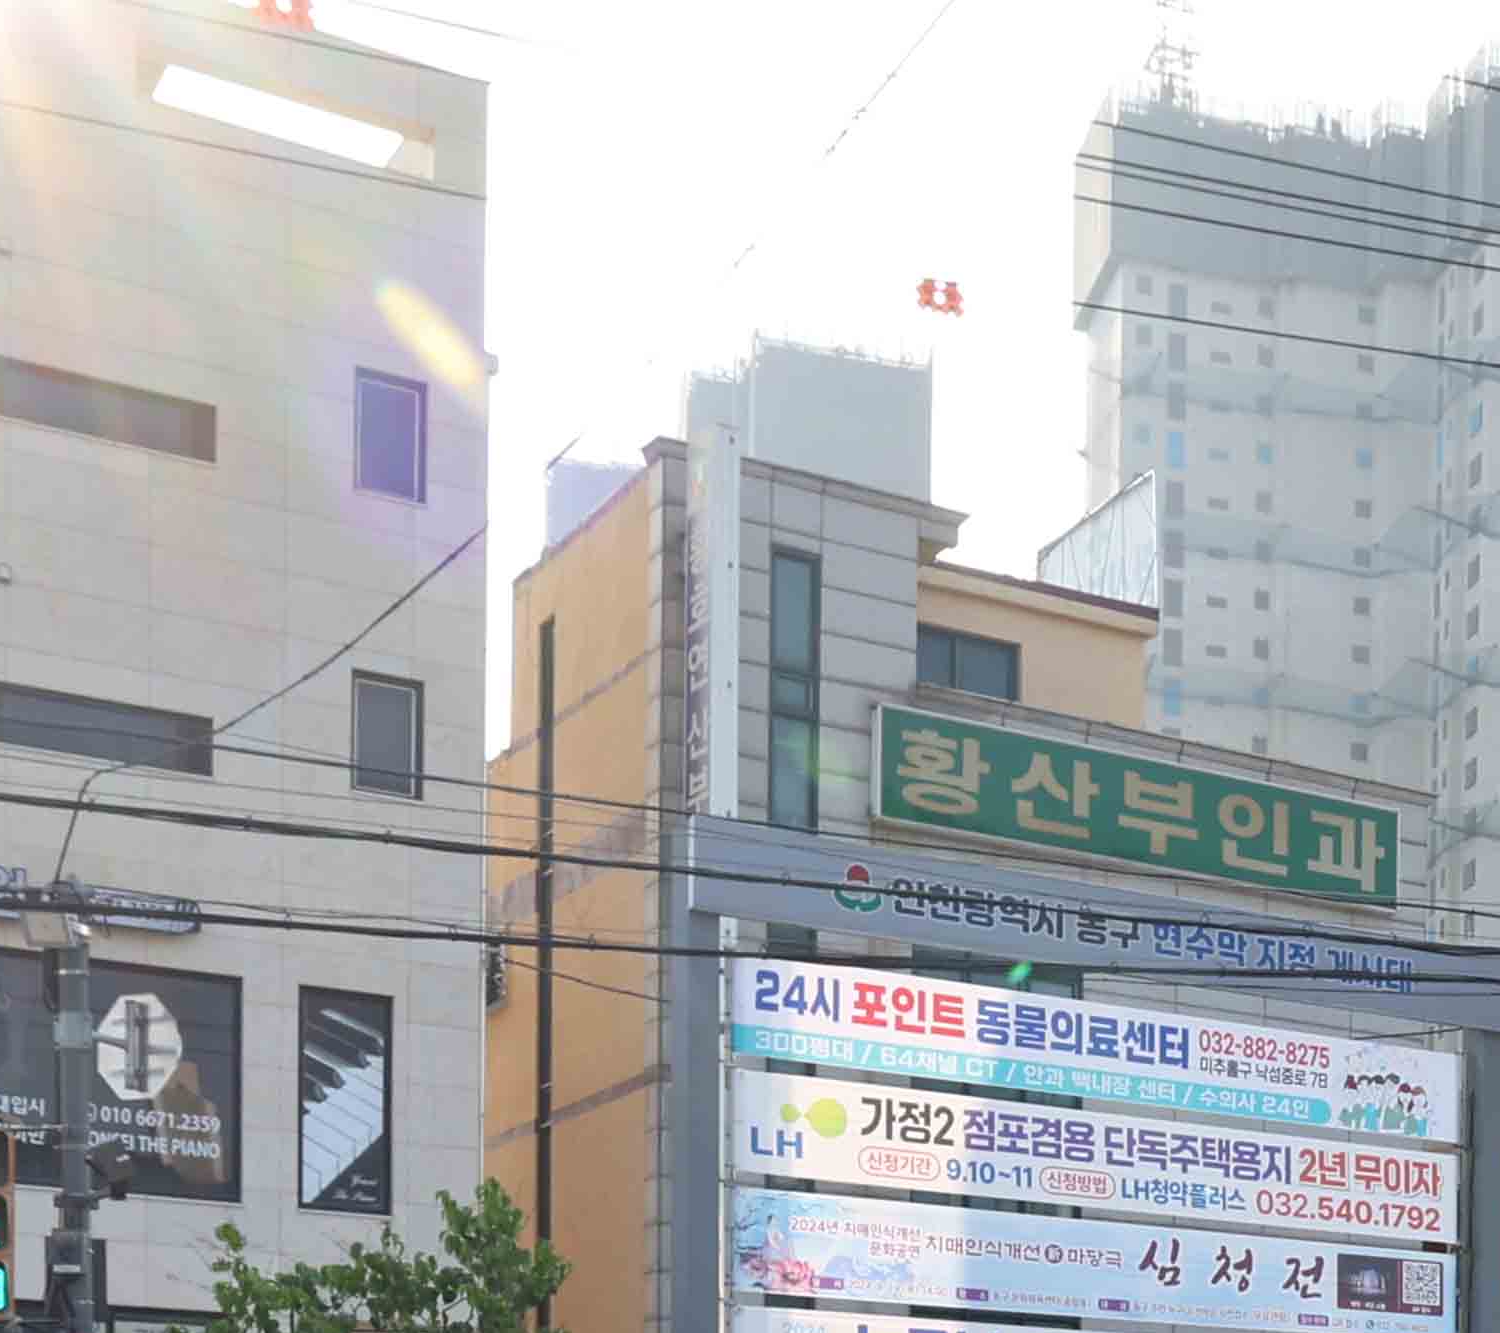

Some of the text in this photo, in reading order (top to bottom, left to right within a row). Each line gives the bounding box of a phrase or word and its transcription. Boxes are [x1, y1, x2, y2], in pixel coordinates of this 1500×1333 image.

[896, 726, 1386, 893] 황산부인과
[892, 877, 1065, 939] 인천광역시
[1076, 902, 1141, 949] 동구
[1153, 922, 1248, 968] 현수막
[754, 969, 1190, 1070] 24시 포인트 동물의료센터
[1198, 1028, 1331, 1069] 032-882-8275
[1198, 1055, 1254, 1081] 미추홀구
[1255, 1062, 1307, 1087] 낙섬중로
[100, 1104, 132, 1124] 010
[964, 1057, 999, 1079] CT
[1135, 1079, 1177, 1103] 센터
[1199, 1089, 1259, 1114] 수의사
[1262, 1096, 1311, 1121] 24인
[138, 1135, 168, 1154] THE
[171, 1137, 221, 1160] PIANO
[750, 1125, 803, 1160] LH
[860, 1095, 1443, 1198] 가정2 점포겸용 단독주택용지 2년 무이자
[866, 1149, 1442, 1233] 신청기간 9.10~11 신청방법 LH청약플러스 032.540.1792
[924, 1234, 1041, 1263] 치매인식개선
[1067, 1247, 1123, 1269] 마당극
